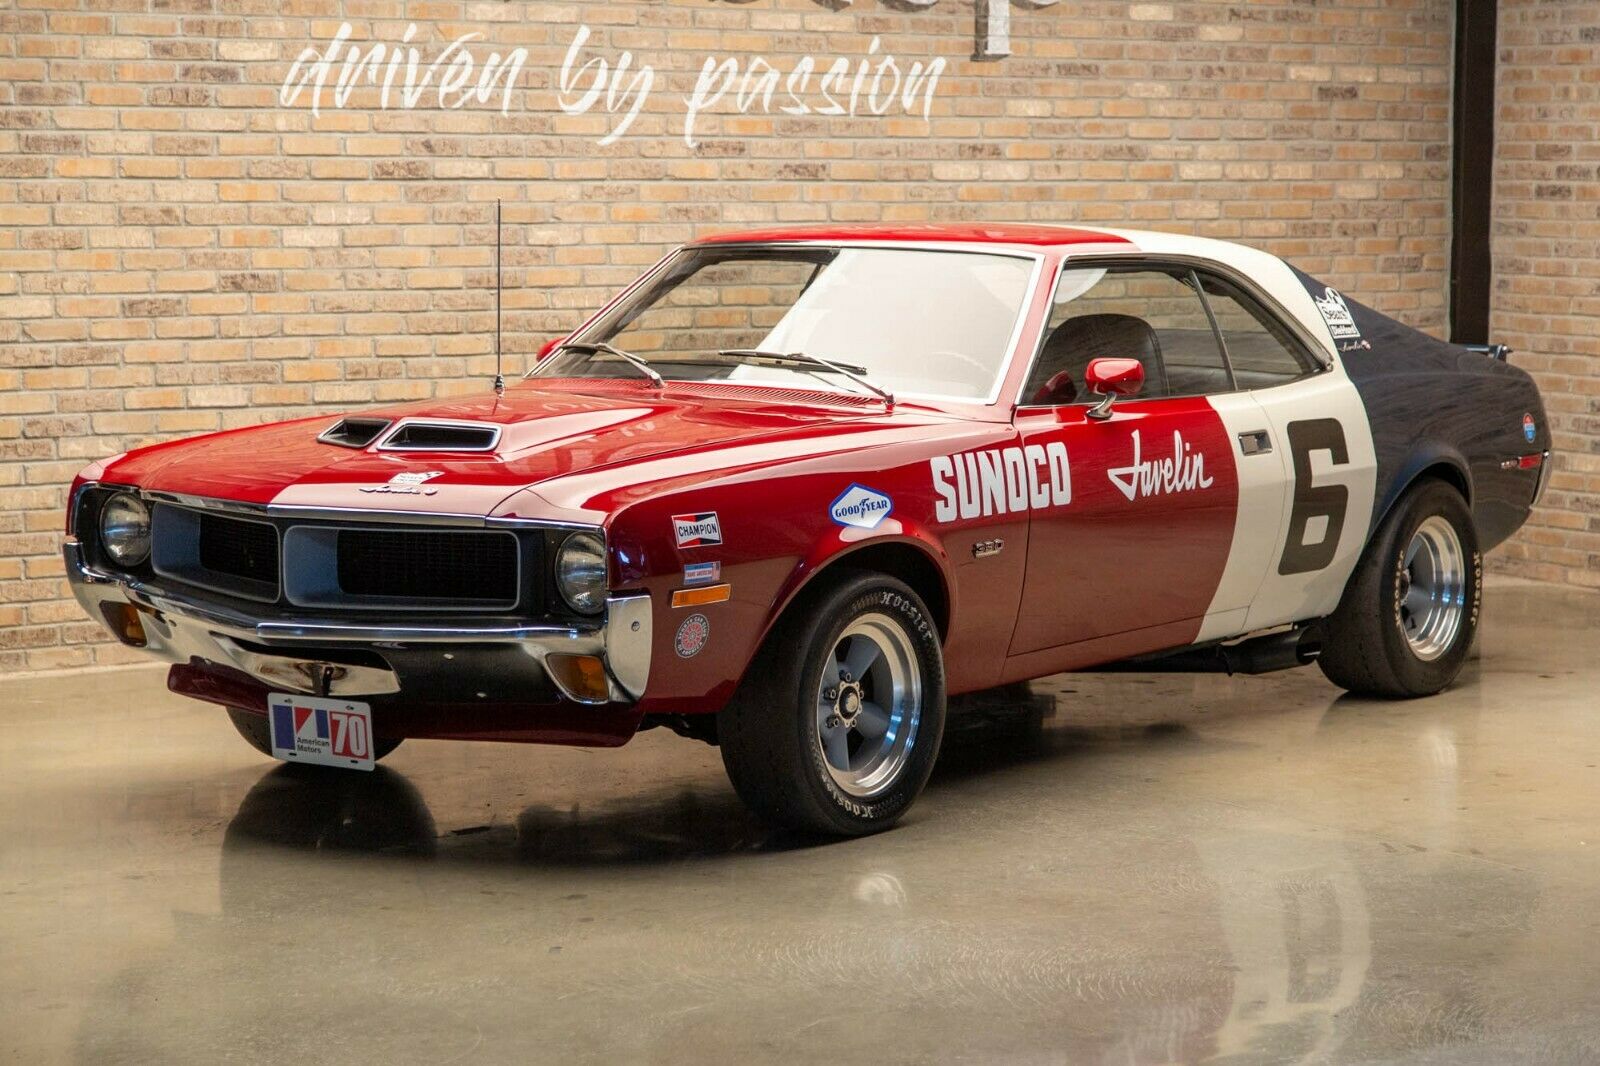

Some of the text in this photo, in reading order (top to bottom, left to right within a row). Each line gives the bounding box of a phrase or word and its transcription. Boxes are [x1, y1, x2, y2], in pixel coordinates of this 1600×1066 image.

[277, 23, 528, 118] driven
[558, 24, 655, 146] by
[683, 36, 947, 148] passion
[930, 442, 1072, 523] SUNOCO
[1107, 429, 1213, 501] Javelin
[834, 498, 888, 518] GOODYEAR
[1277, 417, 1350, 576] 6
[678, 523, 718, 537] CHAMPION
[296, 737, 330, 747] American
[296, 744, 322, 754] Motors
[332, 713, 367, 757] 70
